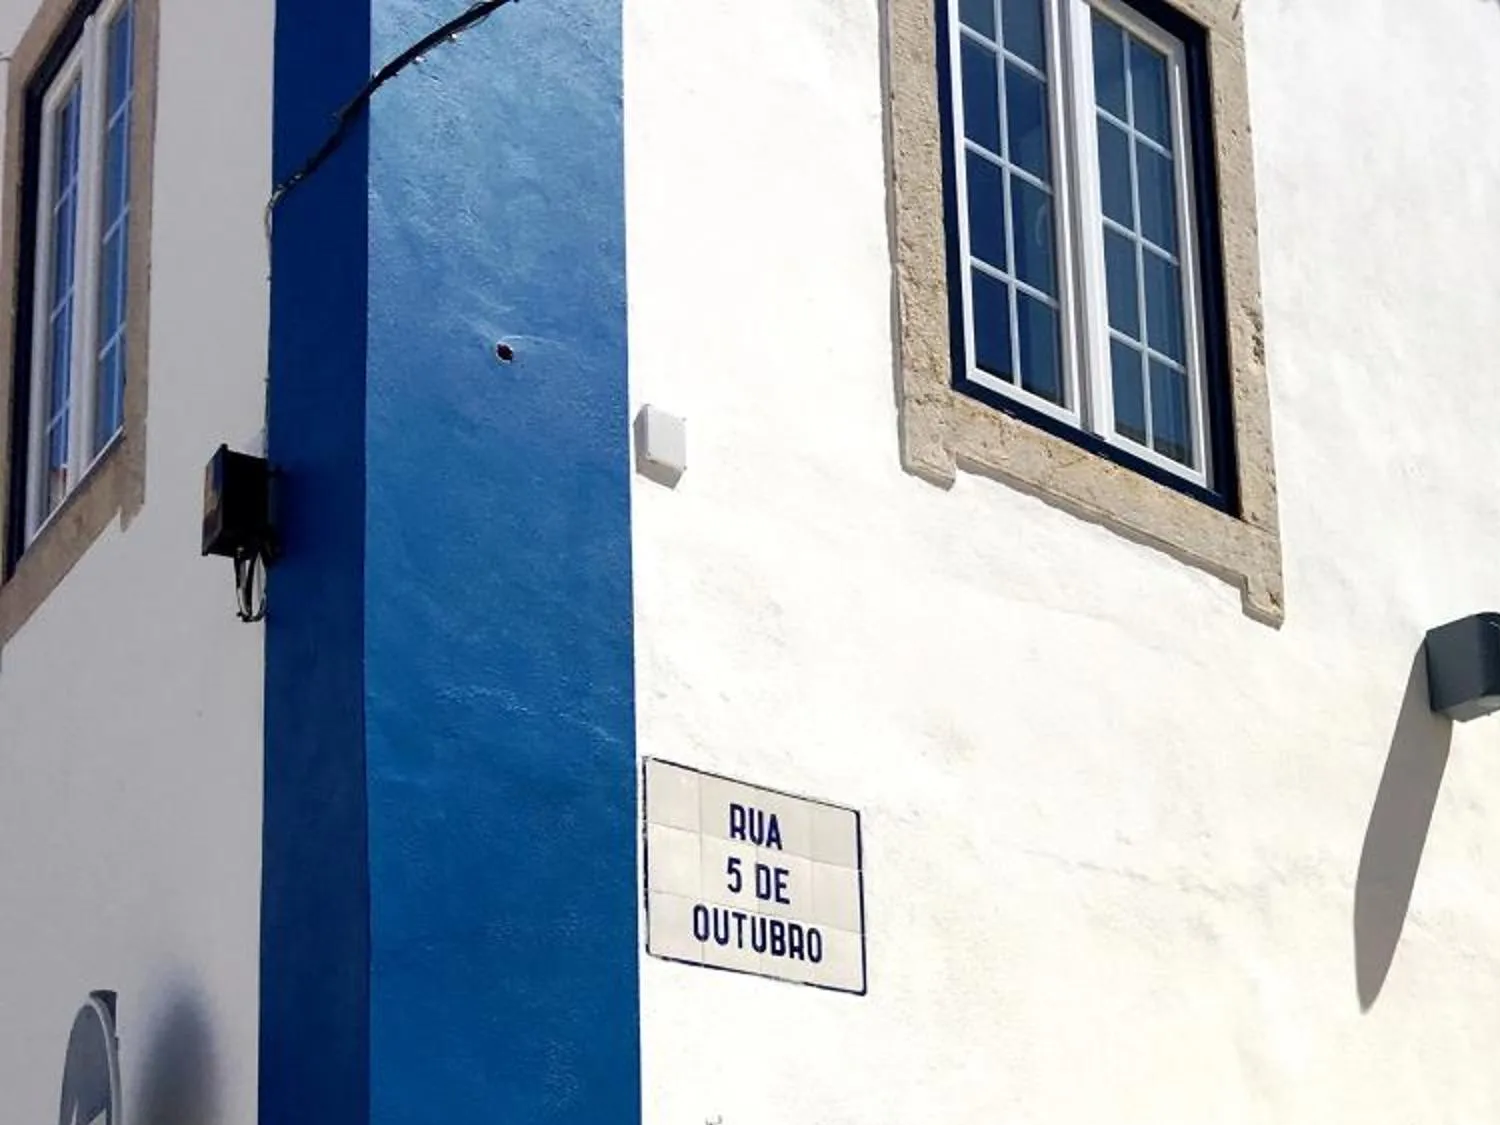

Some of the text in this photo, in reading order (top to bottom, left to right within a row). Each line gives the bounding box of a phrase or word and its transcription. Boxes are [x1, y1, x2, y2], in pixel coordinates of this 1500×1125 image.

[729, 803, 783, 851] RUA
[727, 857, 791, 905] 5 DE
[692, 904, 823, 964] OUTUBRO
